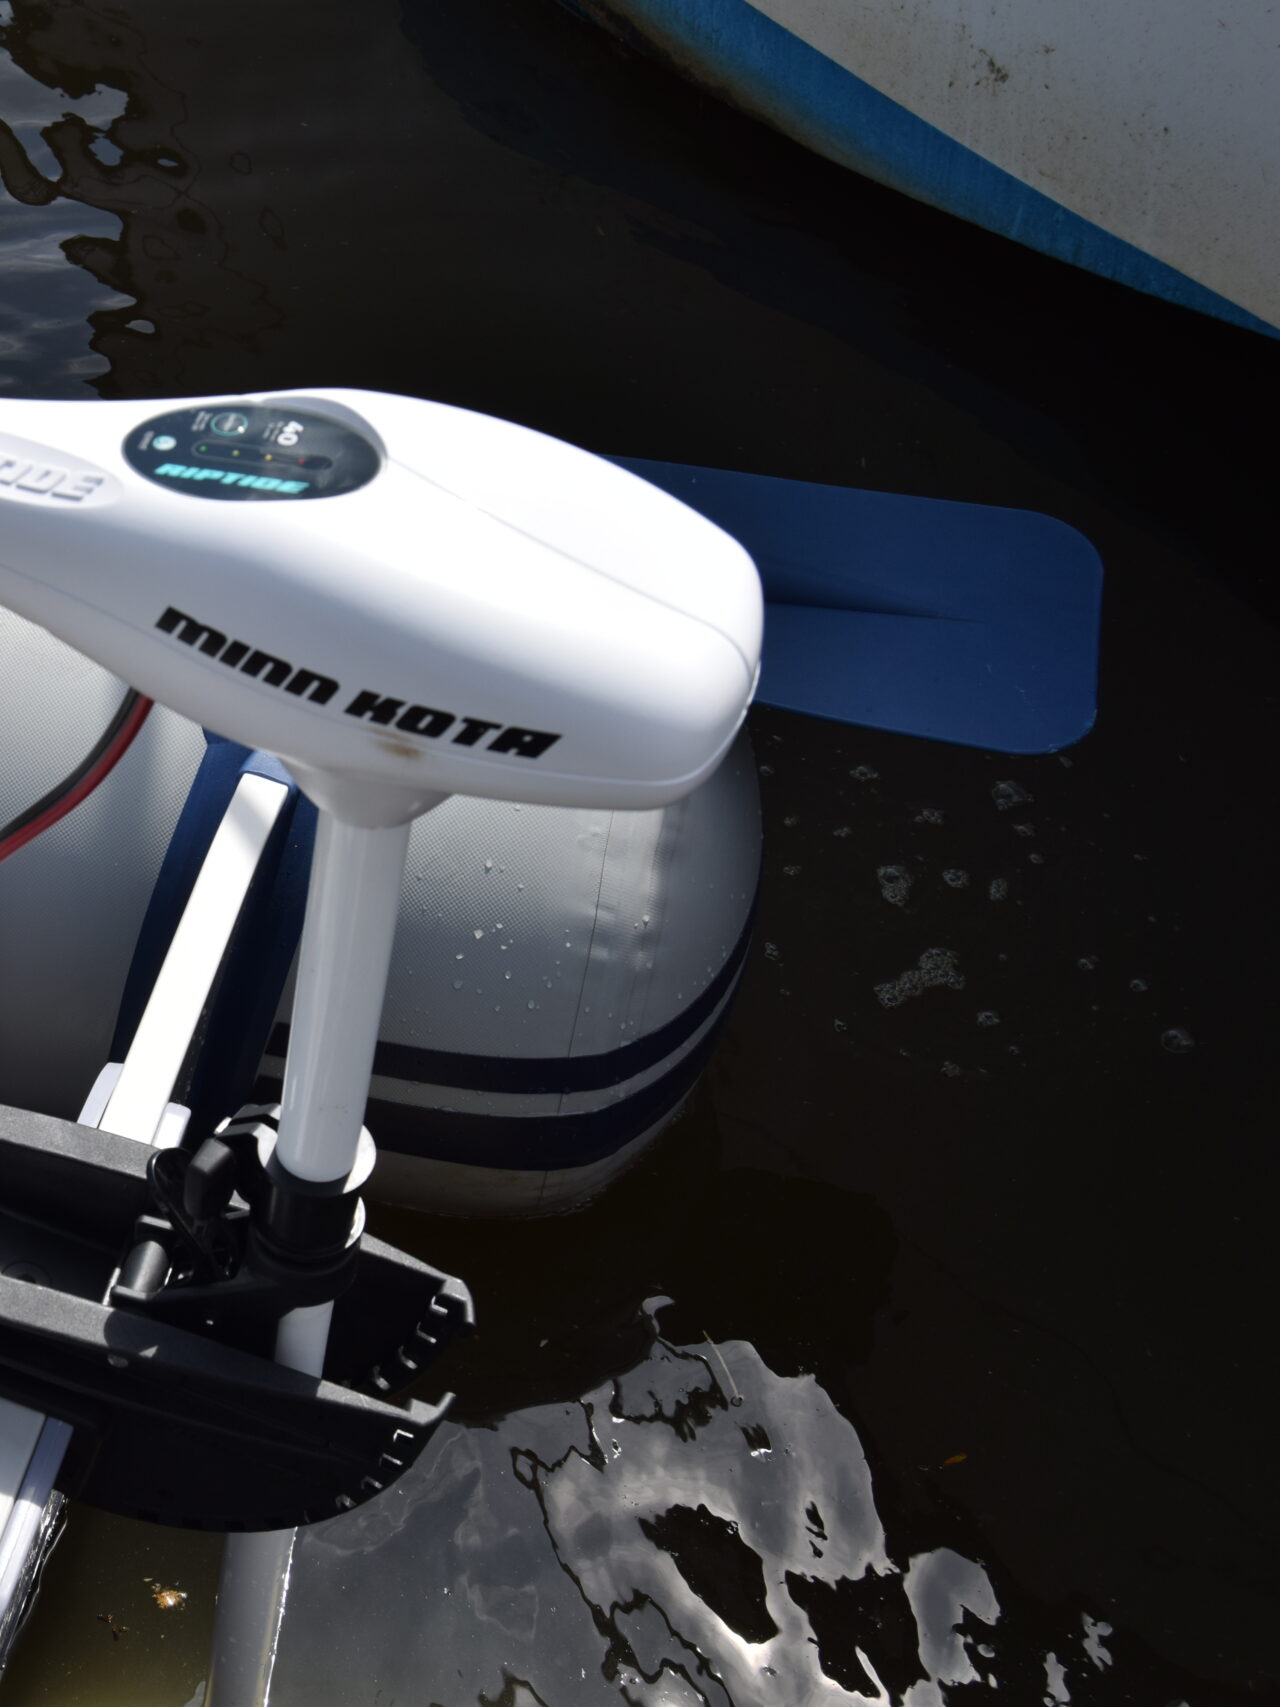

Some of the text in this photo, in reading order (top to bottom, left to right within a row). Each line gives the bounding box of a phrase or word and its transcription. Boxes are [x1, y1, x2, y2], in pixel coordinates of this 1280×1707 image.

[277, 420, 304, 446] 40
[154, 463, 310, 495] RIPTIDE
[343, 689, 563, 759] KOTA
